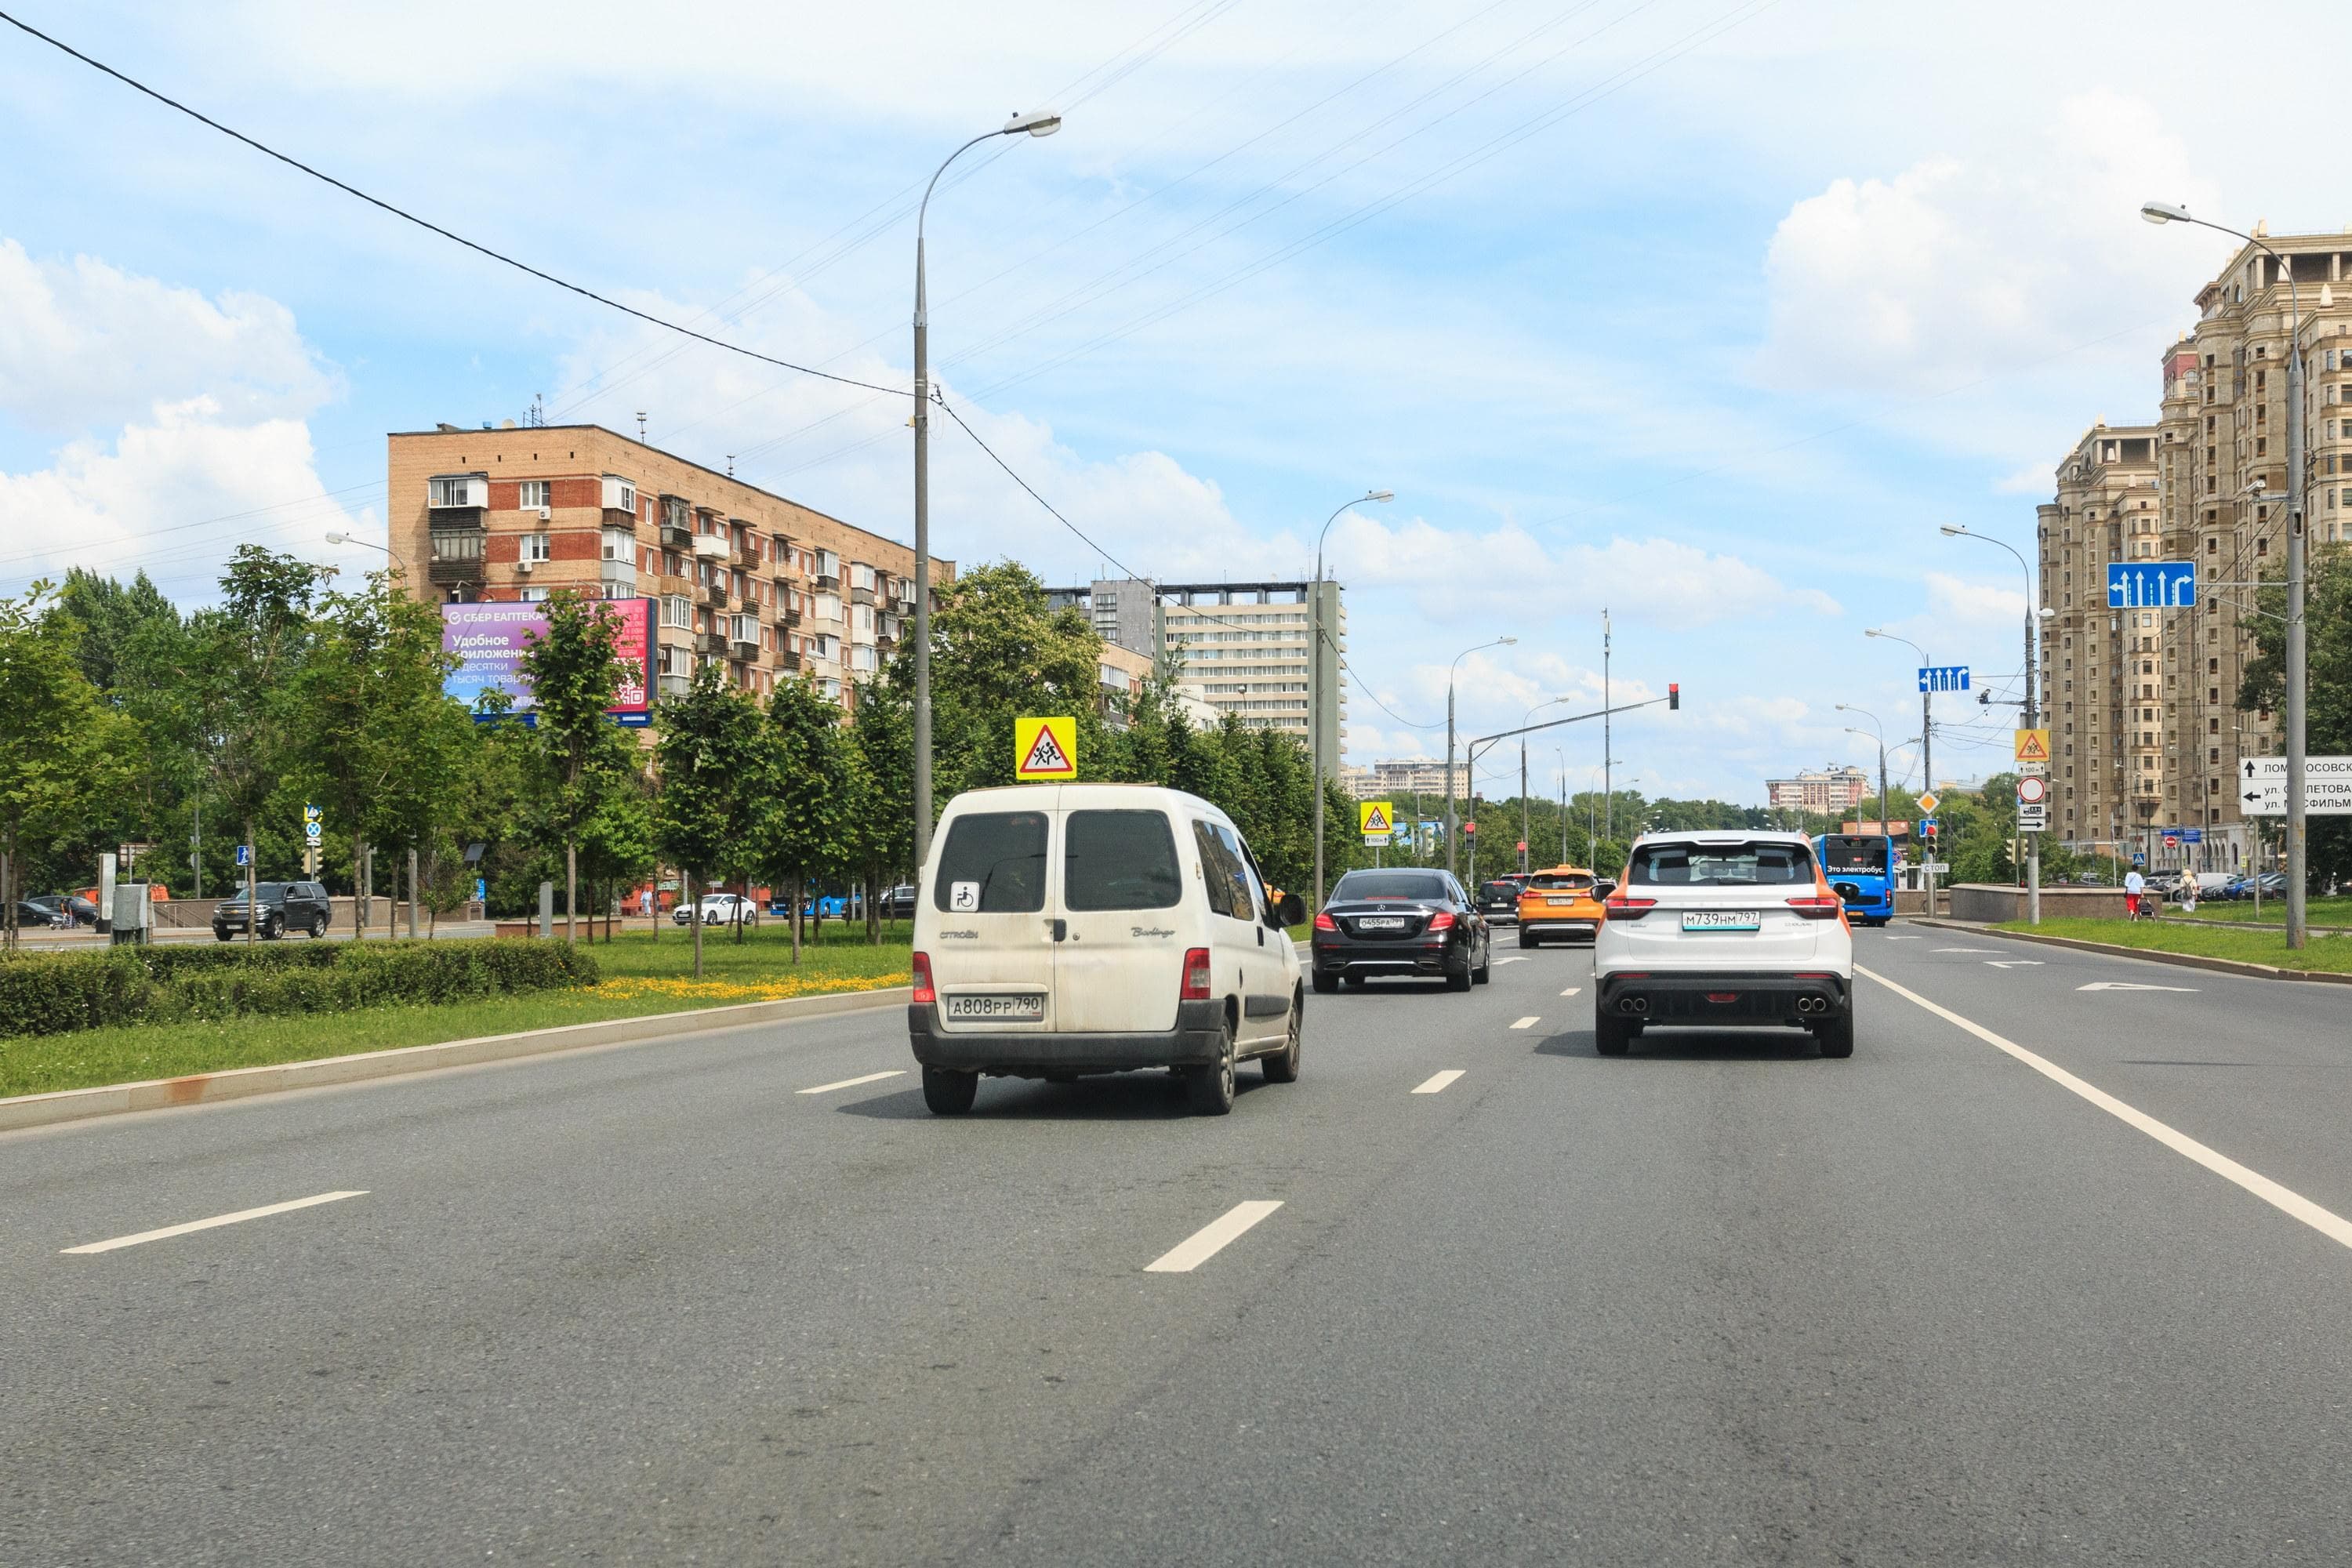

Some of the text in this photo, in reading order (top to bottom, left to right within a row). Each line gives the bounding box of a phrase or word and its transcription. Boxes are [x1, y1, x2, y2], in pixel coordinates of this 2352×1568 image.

[463, 612, 544, 622] СБЕР ЕАПТЕКА
[452, 633, 509, 648] Удобное
[462, 662, 508, 673] десятки
[452, 675, 485, 684] тысяч
[2264, 763, 2352, 773] ЛОМОСОВСК
[2264, 784, 2351, 796] ул. СЛЕТОВА
[2264, 799, 2351, 810] ул. ФИЛЬМ
[1842, 866, 1885, 874] электробус.
[1686, 912, 1757, 925] М739НМ 797
[953, 997, 1039, 1014] А808РР 790
